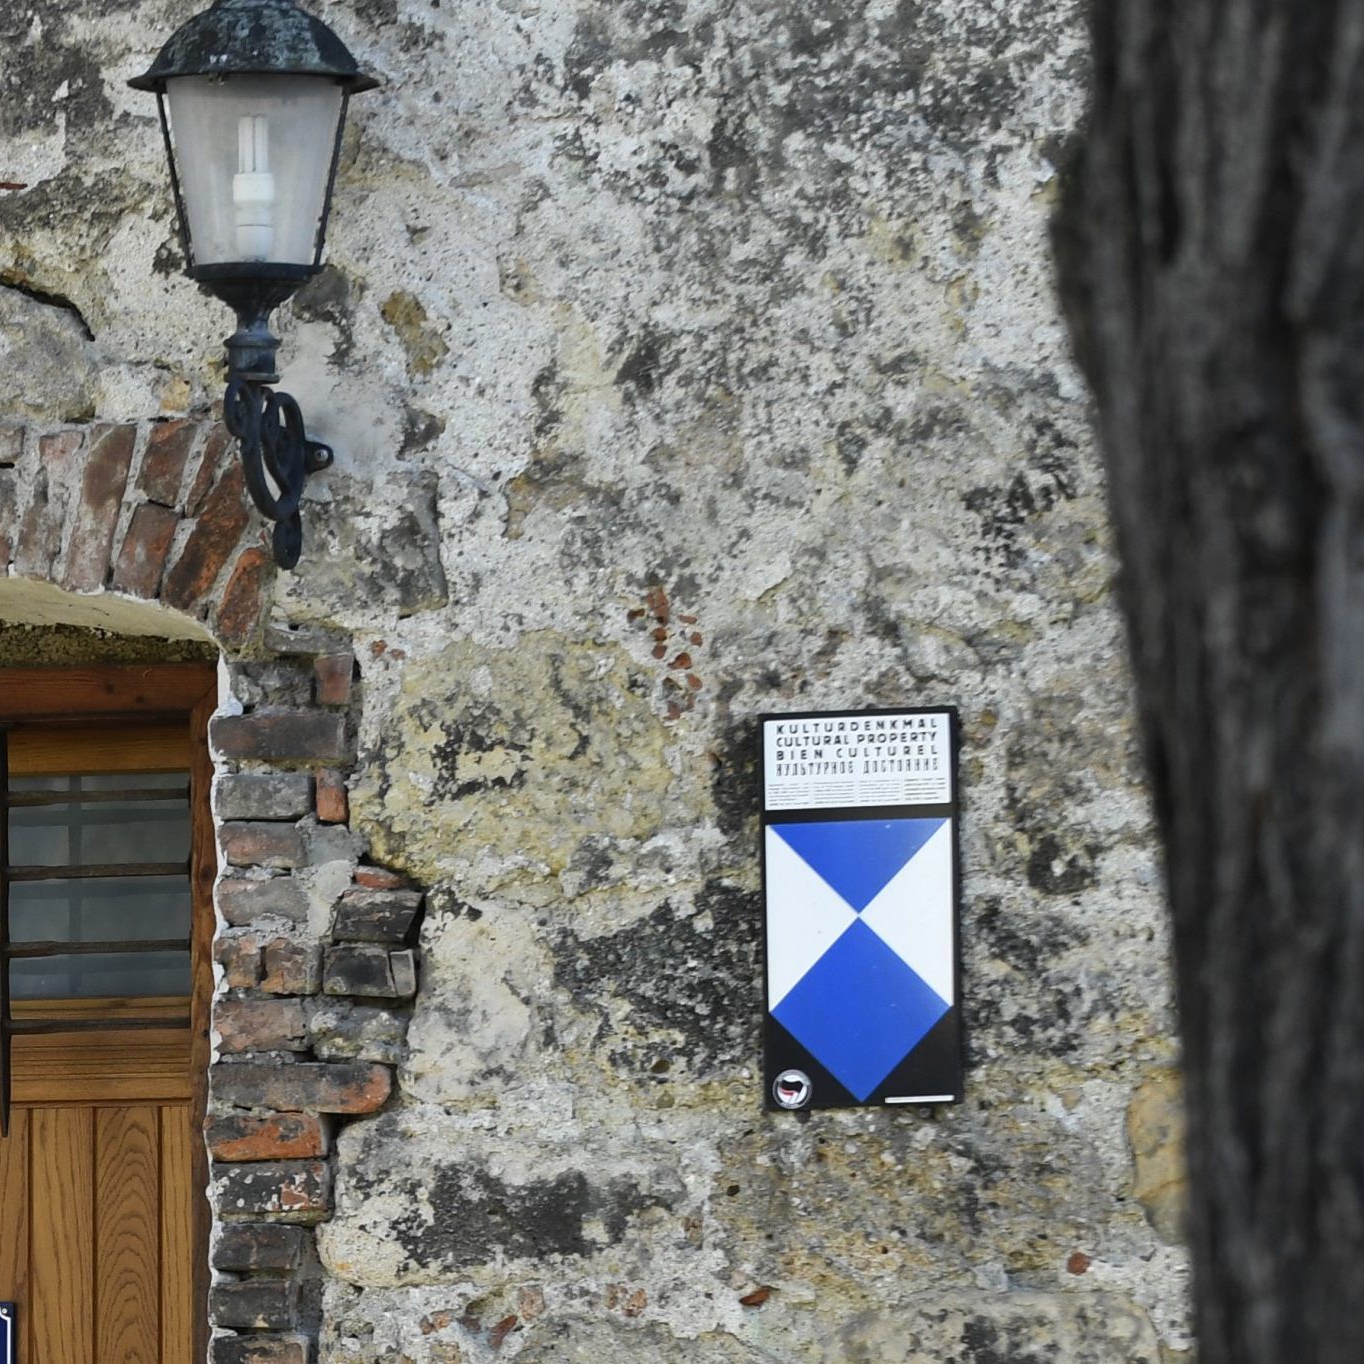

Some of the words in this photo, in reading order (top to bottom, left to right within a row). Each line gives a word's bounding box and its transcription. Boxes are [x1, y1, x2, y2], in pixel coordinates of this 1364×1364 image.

[776, 718, 938, 735] KULTURDENKMAL
[776, 735, 850, 748] CULTURAL
[857, 732, 937, 744] PROPERTY
[776, 749, 823, 761] BIEN
[836, 746, 938, 758] CULTUREL
